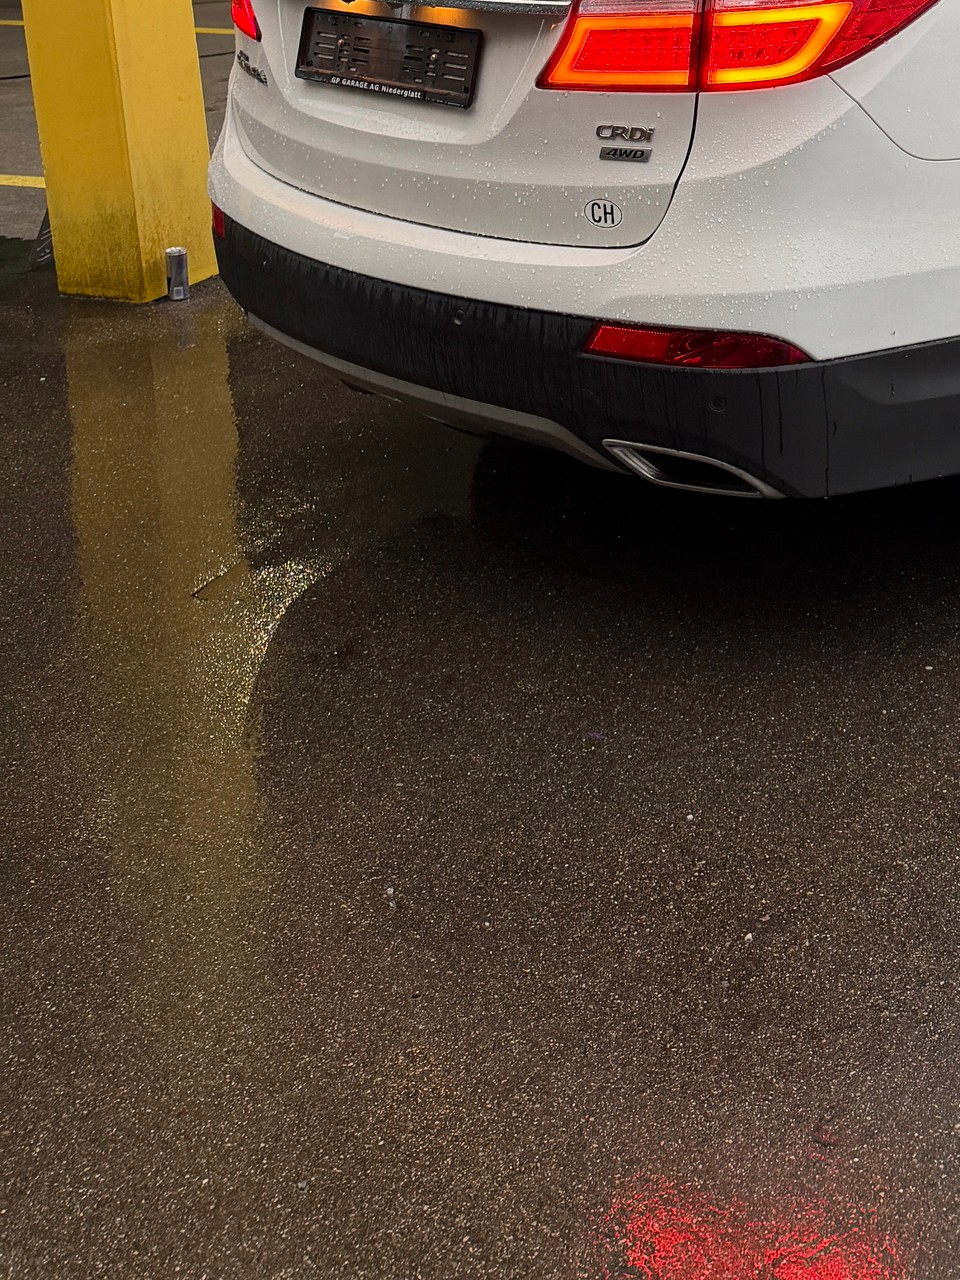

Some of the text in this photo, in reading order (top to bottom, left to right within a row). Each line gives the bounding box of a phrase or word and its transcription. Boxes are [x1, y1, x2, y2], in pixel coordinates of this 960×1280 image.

[331, 76, 341, 84] GP
[342, 78, 369, 89] GARAGE
[369, 82, 379, 91] AG
[381, 85, 422, 99] Niederglatt
[596, 125, 655, 142] CRDi
[606, 148, 645, 159] 4WD
[591, 202, 615, 224] CH
